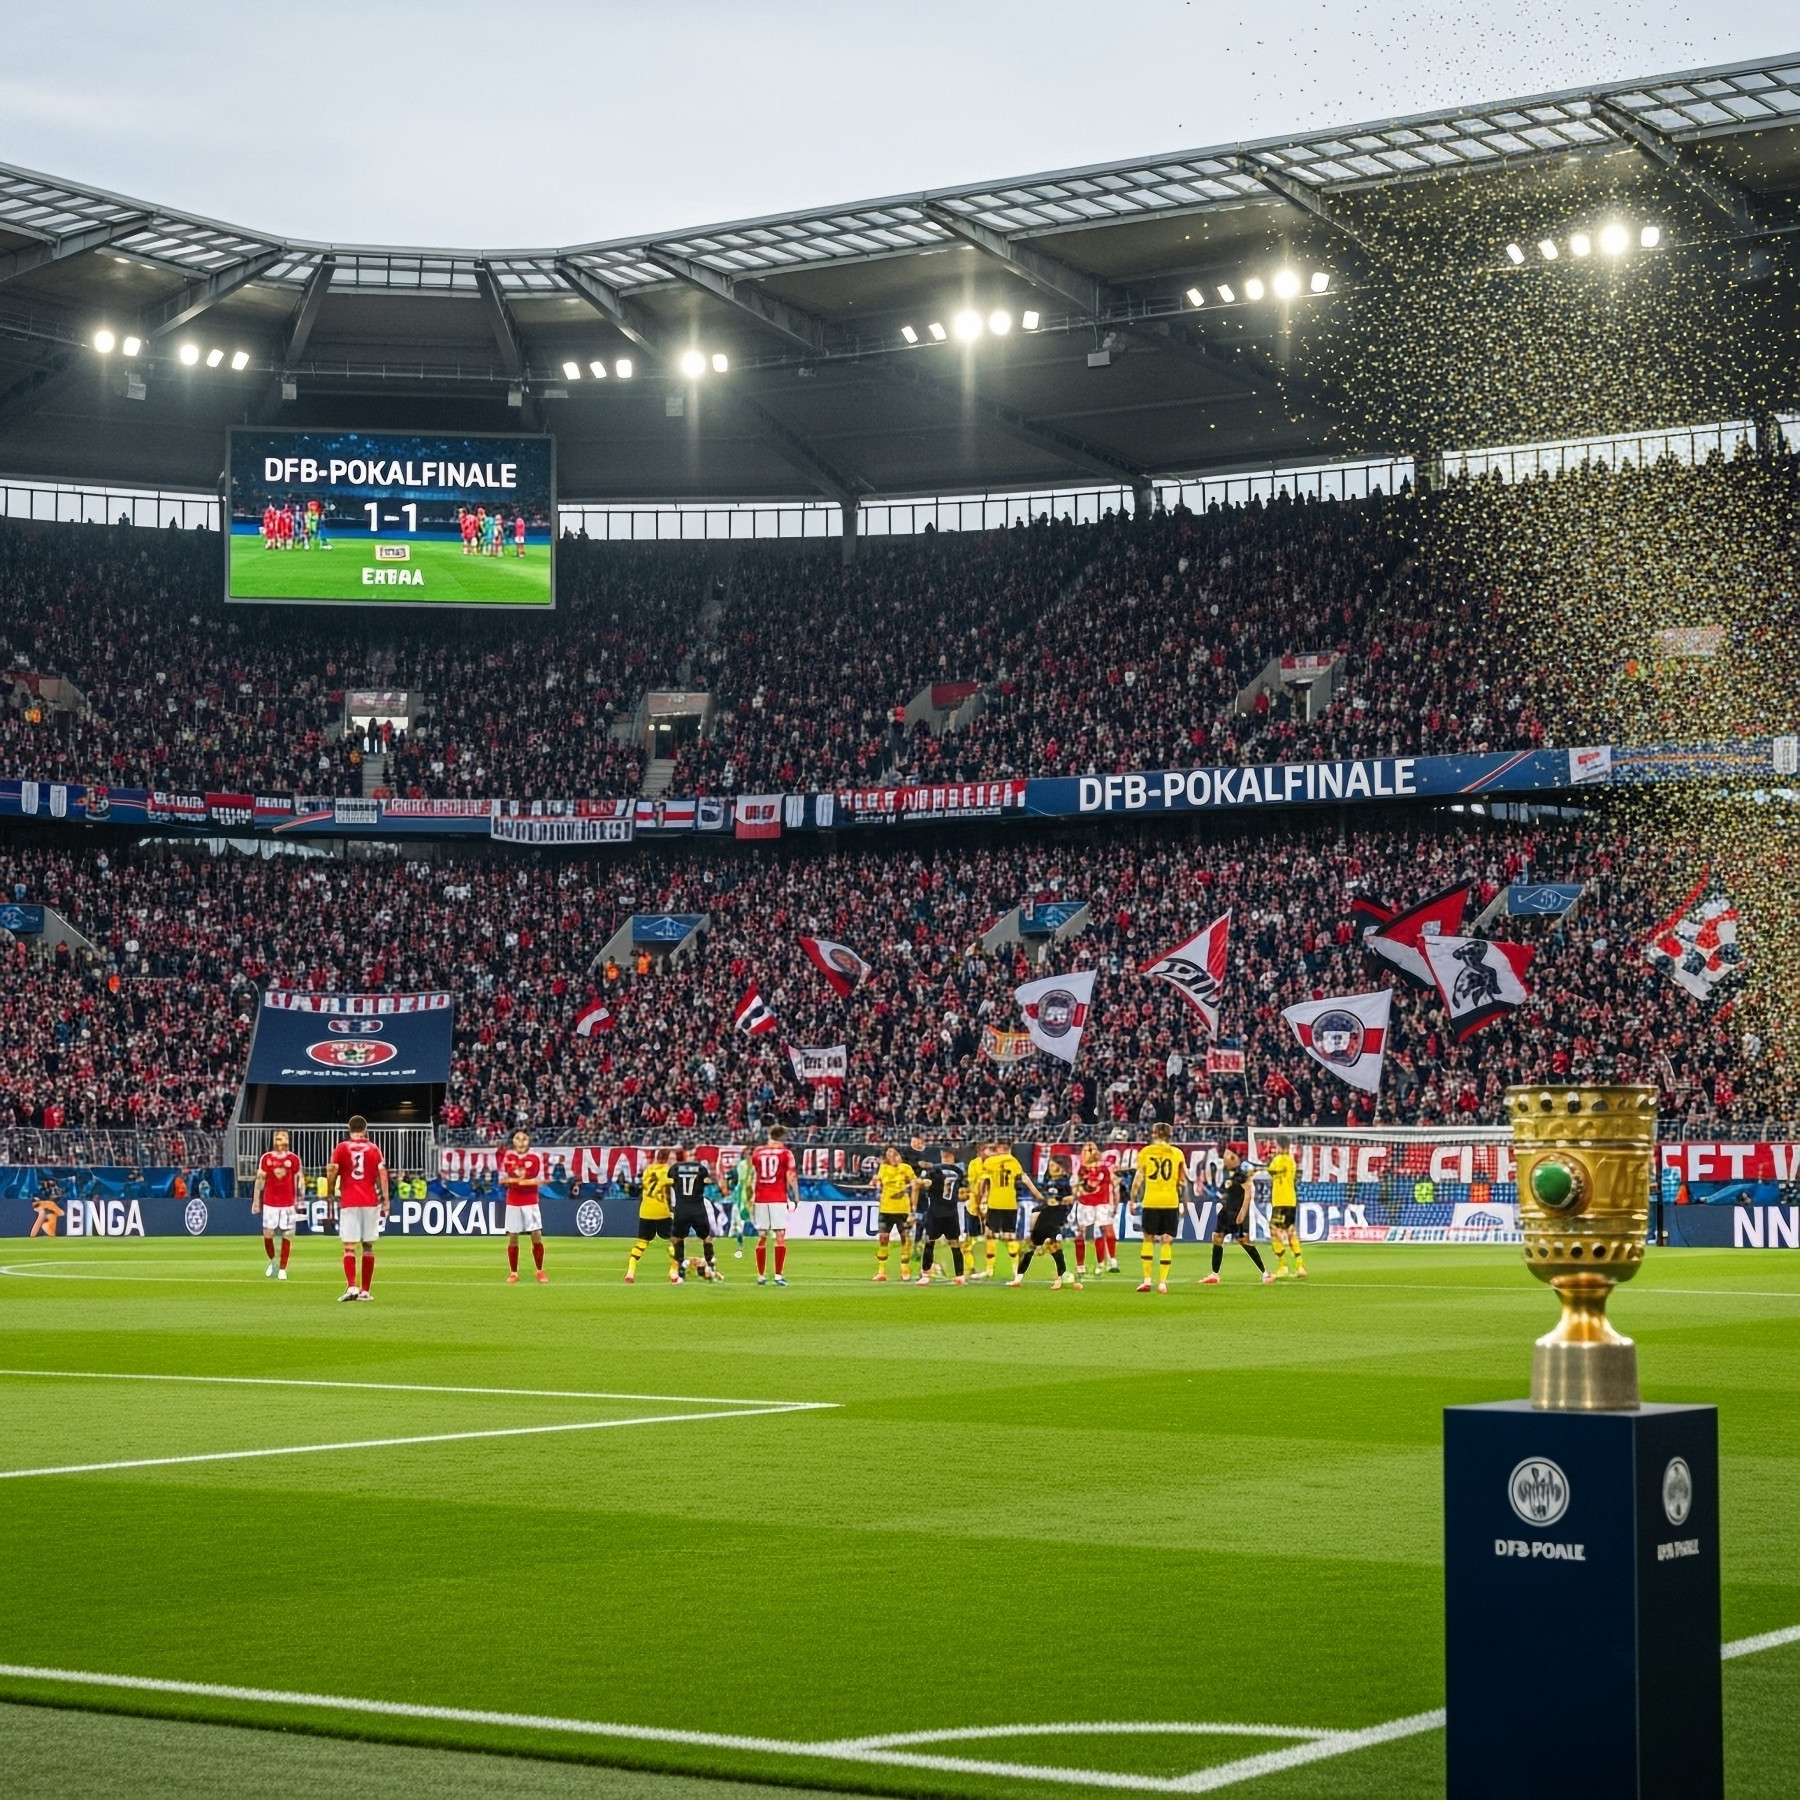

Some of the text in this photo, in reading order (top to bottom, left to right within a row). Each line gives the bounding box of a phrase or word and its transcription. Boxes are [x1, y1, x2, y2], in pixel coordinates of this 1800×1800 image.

[265, 457, 517, 488] DFB-POKALFINALE
[363, 502, 417, 532] 1-1
[1079, 759, 1417, 812] DFB-POKALFINALE
[66, 1199, 145, 1237] BNGA
